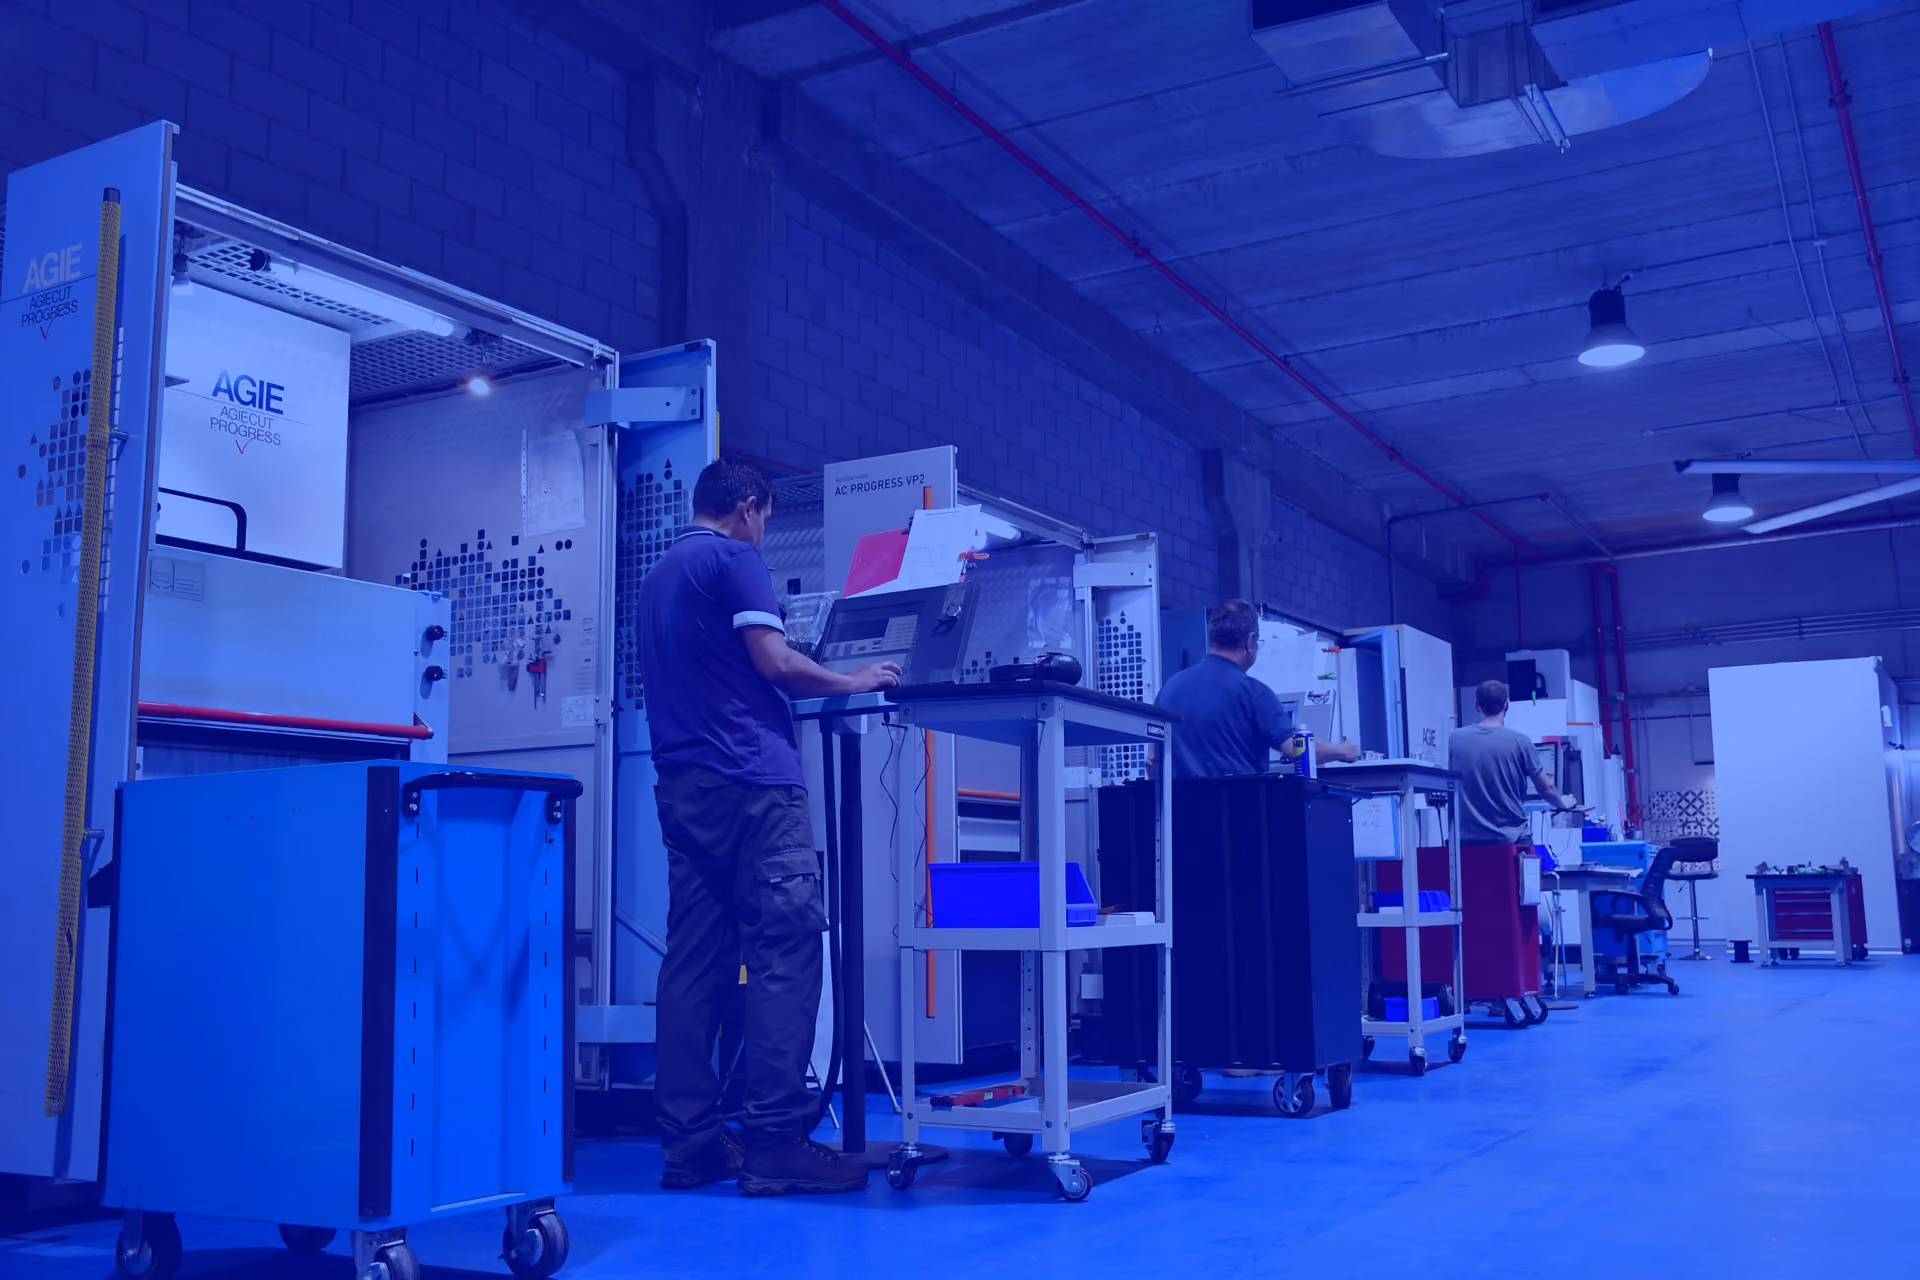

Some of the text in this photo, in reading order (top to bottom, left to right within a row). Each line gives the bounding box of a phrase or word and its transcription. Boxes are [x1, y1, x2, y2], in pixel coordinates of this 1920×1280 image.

[23, 243, 83, 293] AGIE
[30, 286, 72, 310] AGIECUT
[21, 299, 78, 328] PROGRESS
[212, 369, 285, 415] AGIE
[210, 416, 281, 446] PROGRESS
[220, 406, 274, 429] AGIECUT
[834, 485, 848, 496] AC
[850, 477, 904, 494] PROGRESS
[905, 473, 925, 486] VP2
